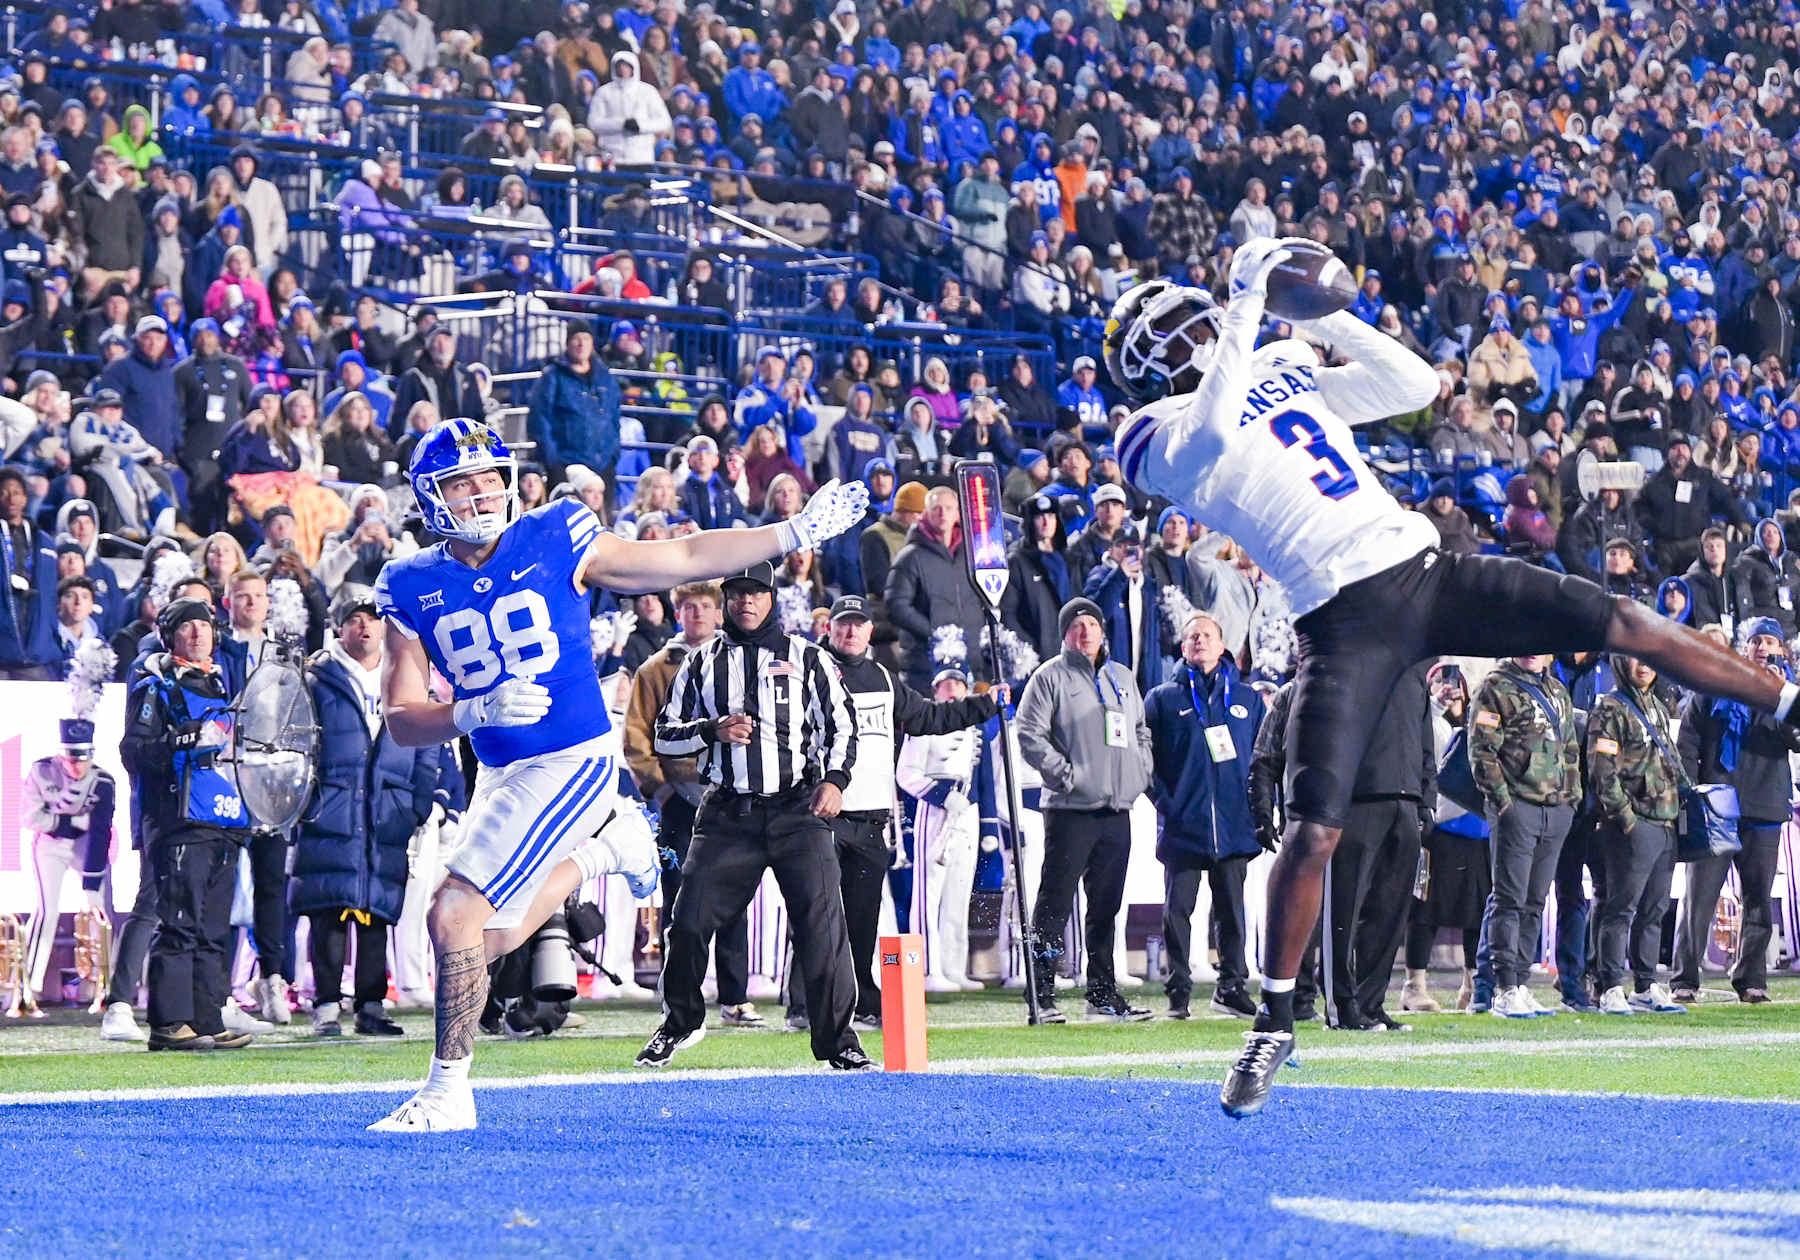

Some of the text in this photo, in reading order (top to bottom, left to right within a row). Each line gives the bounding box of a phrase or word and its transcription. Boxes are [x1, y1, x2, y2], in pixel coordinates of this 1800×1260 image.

[1240, 365, 1321, 428] ANSAS
[1269, 408, 1360, 502] 3
[433, 588, 560, 690] 88
[775, 686, 788, 704] L
[176, 732, 197, 746] FOX
[213, 794, 241, 820] 398
